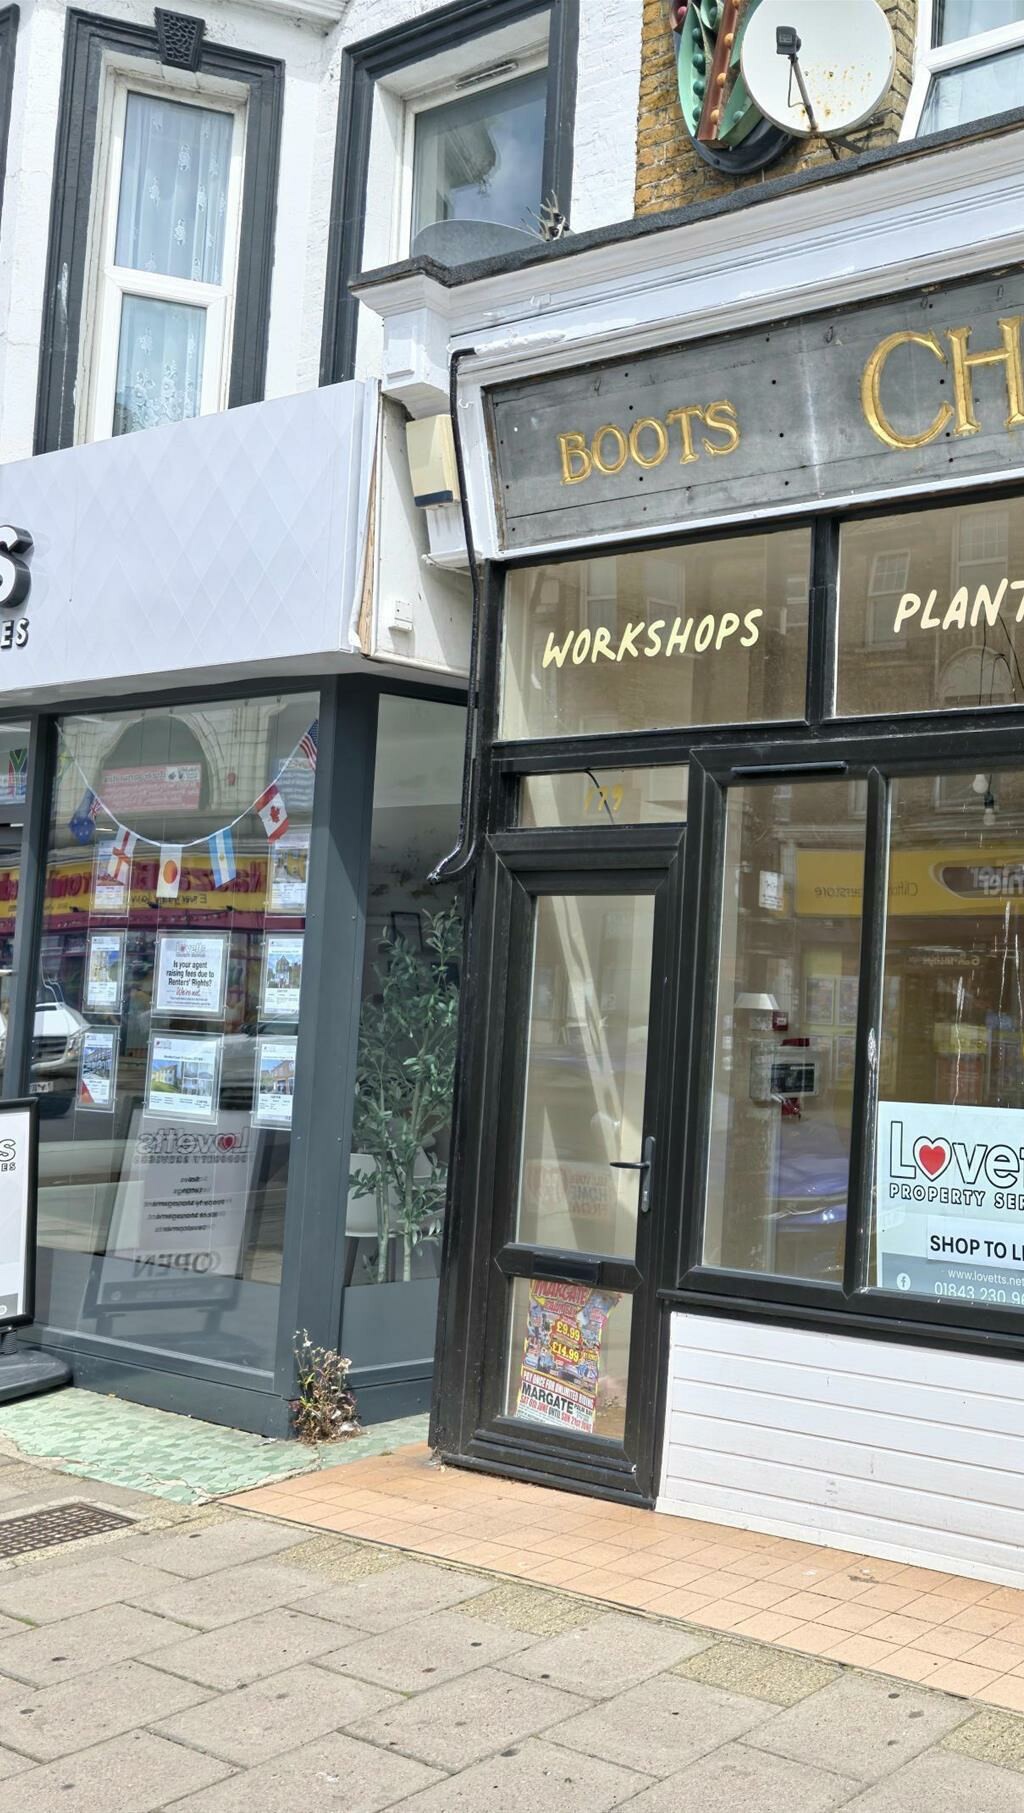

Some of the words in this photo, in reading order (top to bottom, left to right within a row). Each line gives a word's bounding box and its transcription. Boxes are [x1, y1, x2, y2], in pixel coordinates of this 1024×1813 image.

[556, 399, 741, 486] BOOTS
[541, 608, 763, 670] WORKSHOPS
[166, 969, 184, 979] raising
[185, 970, 196, 978] fees
[197, 970, 208, 978] due
[209, 970, 215, 978] to
[179, 961, 191, 969] your
[192, 961, 208, 970] agent
[192, 979, 212, 988] Rights?
[889, 1183, 986, 1207] PROPERTY
[930, 1235, 980, 1255] SHOP
[984, 1241, 1007, 1259] TO
[934, 1281, 975, 1299] 01843
[980, 1287, 1006, 1303] 230
[557, 1321, 579, 1340] £9.99
[552, 1342, 579, 1362] £14.99
[521, 1382, 574, 1414] MARGATE
